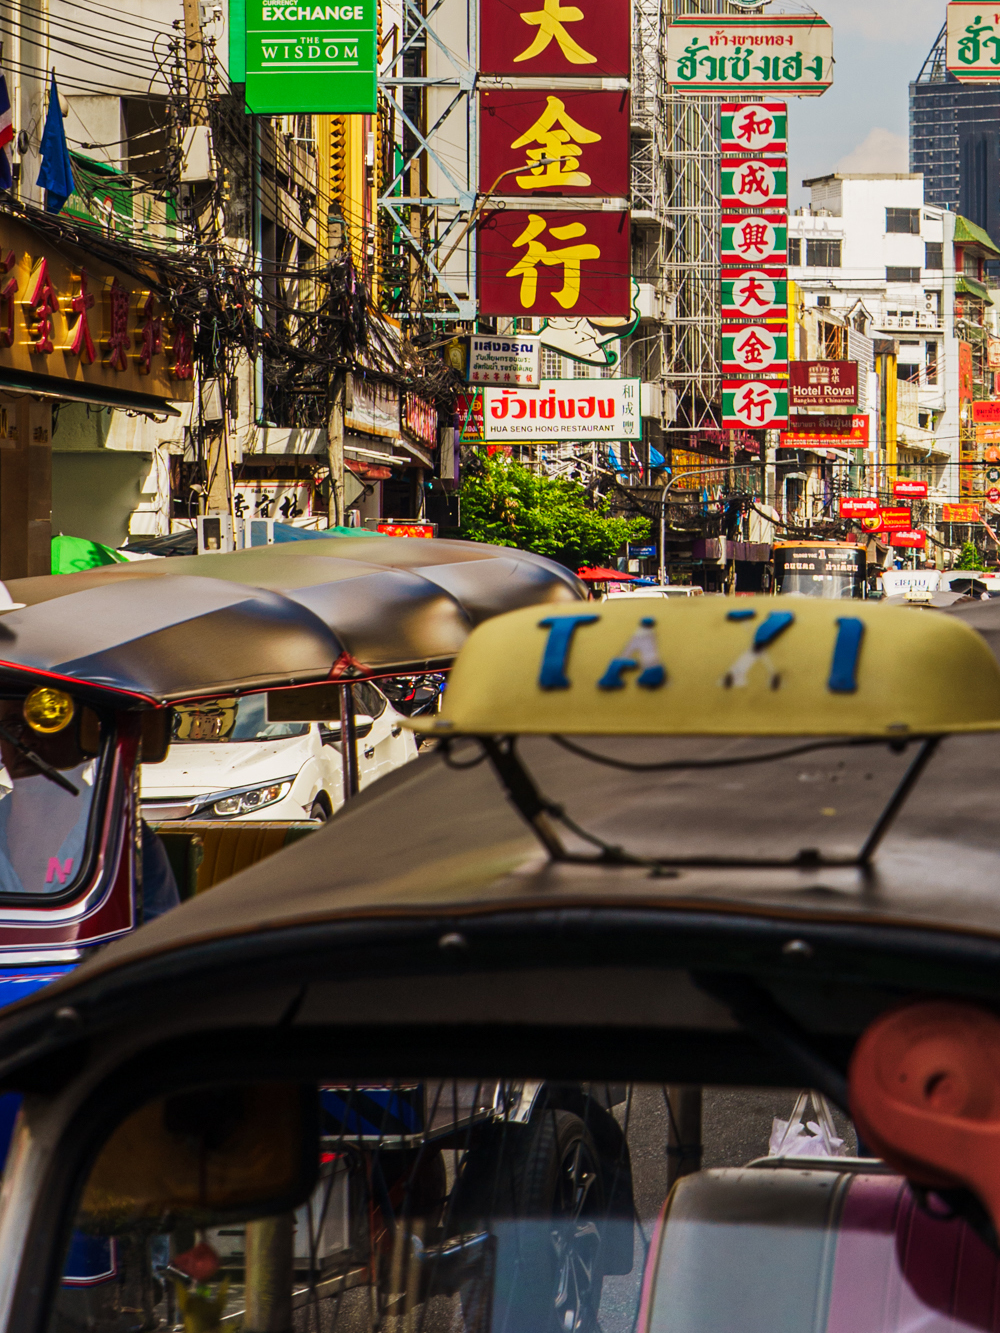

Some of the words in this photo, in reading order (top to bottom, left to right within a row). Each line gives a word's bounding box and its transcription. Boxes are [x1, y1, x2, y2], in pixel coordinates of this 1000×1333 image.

[262, 0, 299, 7] CURRENCY
[262, 6, 364, 22] EXCHANGE
[709, 30, 793, 46] ห้างขายทอง
[262, 45, 359, 59] WISDOM
[737, 111, 773, 422] 和成興大金行
[474, 341, 534, 356] แสงอรุณ
[793, 385, 821, 396] Hotel
[824, 385, 854, 396] Royal
[818, 549, 826, 560] 1
